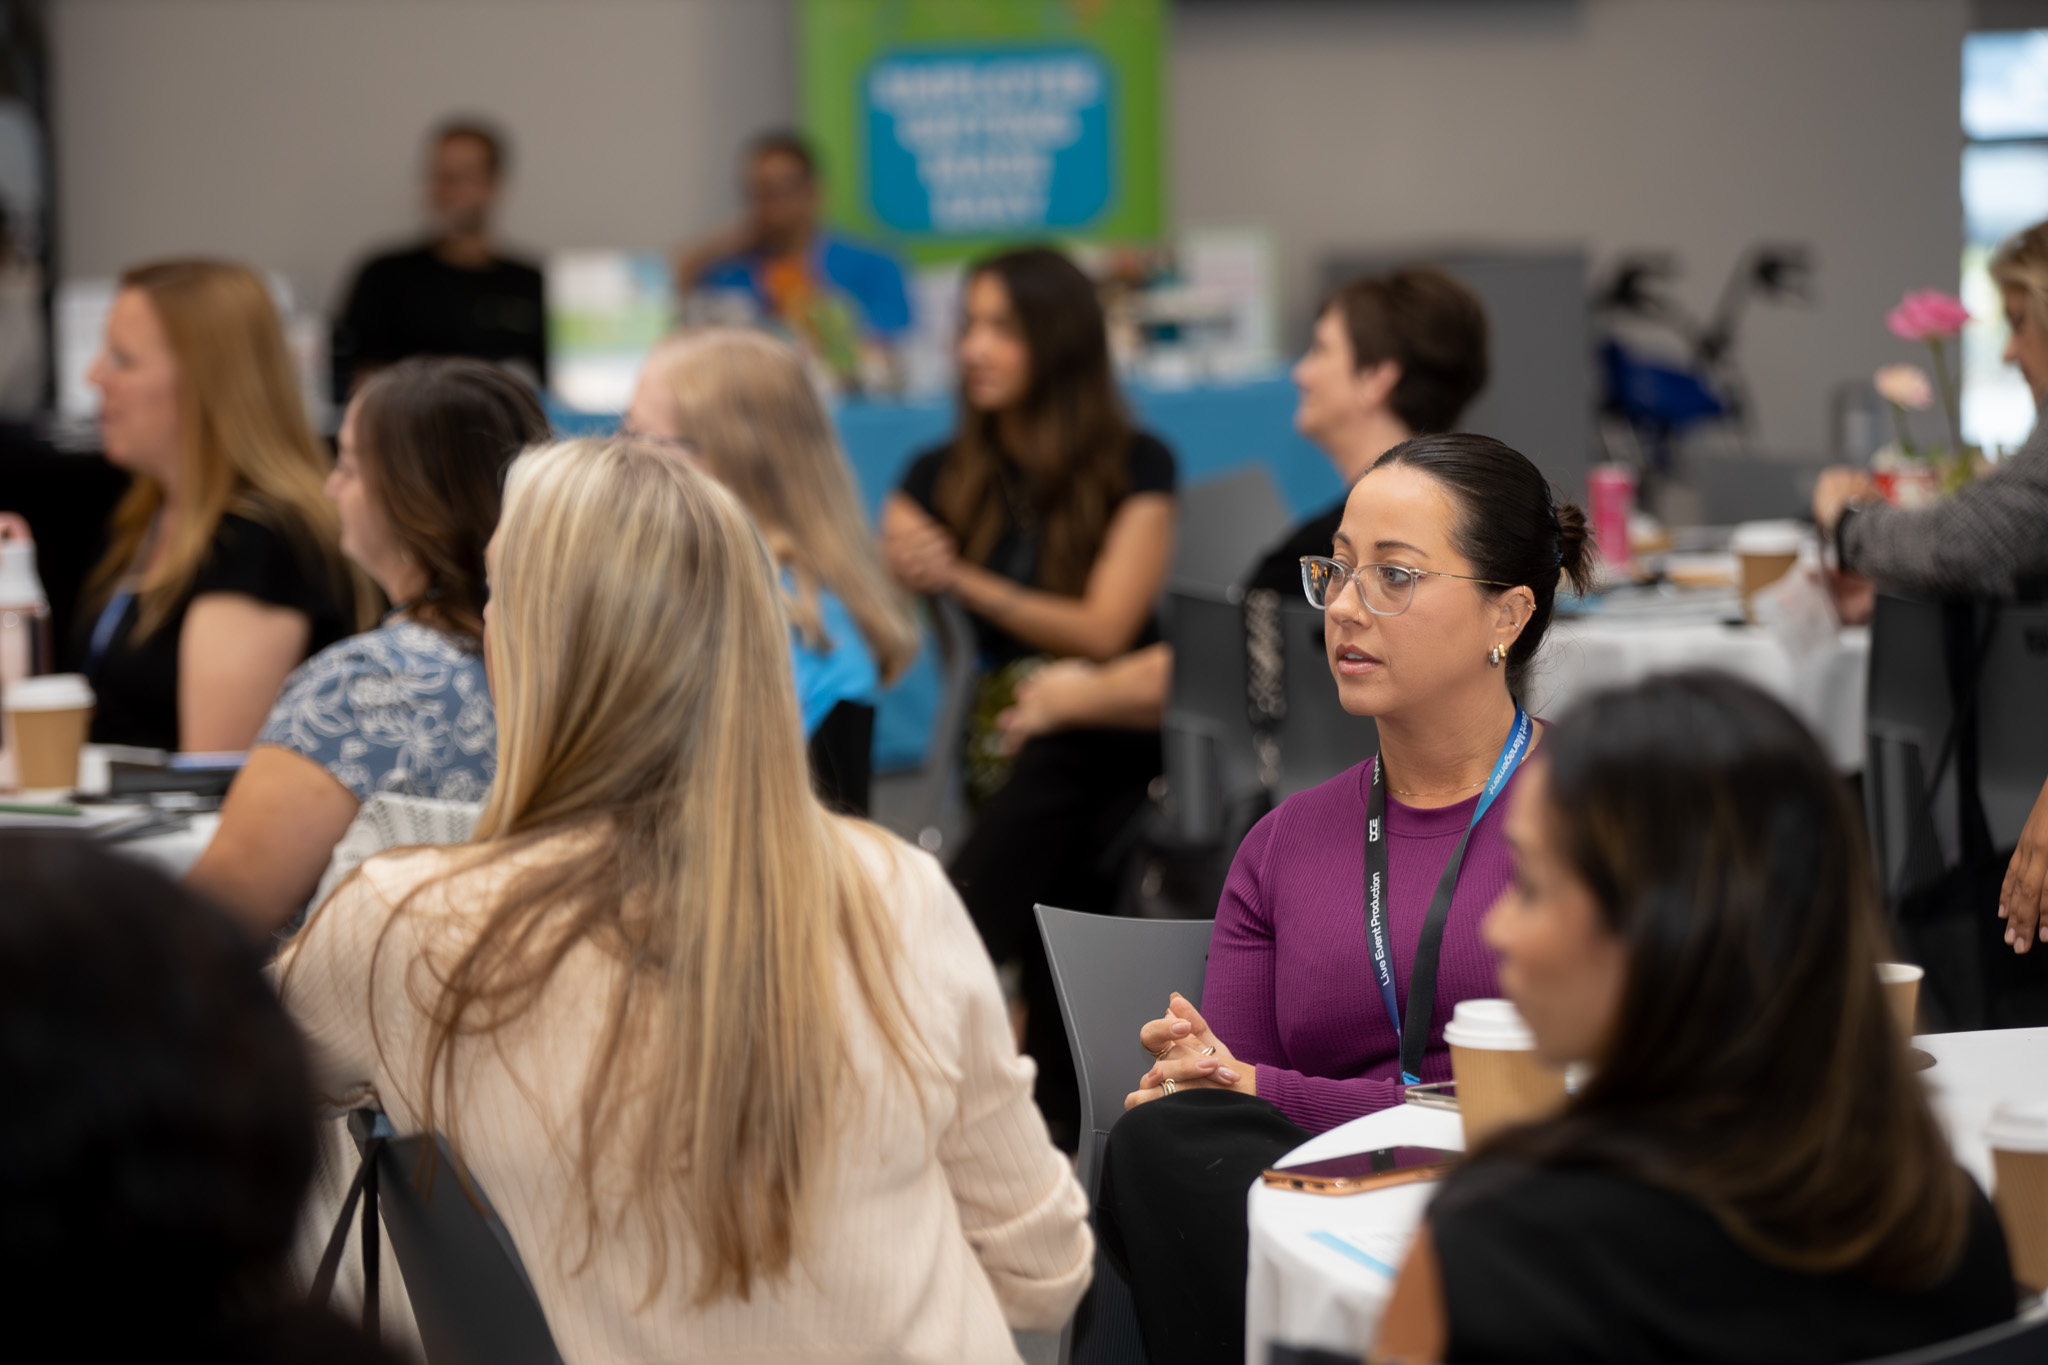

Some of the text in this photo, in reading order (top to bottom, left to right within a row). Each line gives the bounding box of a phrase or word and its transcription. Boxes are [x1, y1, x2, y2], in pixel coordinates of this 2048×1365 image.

[1488, 731, 1526, 795] Management
[1370, 871, 1390, 986] Live Event Production
